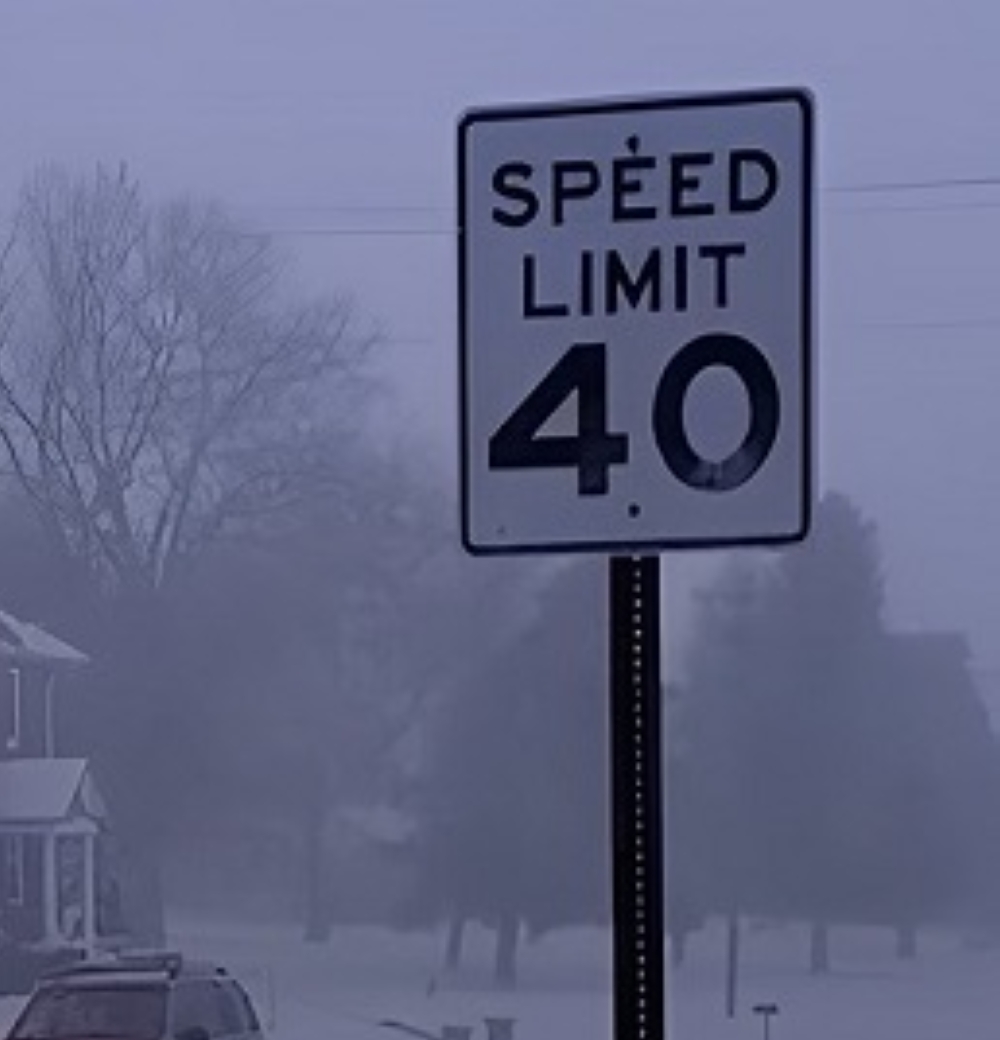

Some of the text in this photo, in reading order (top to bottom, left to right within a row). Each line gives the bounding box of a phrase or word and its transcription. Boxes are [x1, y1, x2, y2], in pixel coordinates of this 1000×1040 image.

[490, 147, 781, 229] SPEED
[521, 240, 748, 321] LIMIT
[487, 330, 782, 500] 40
